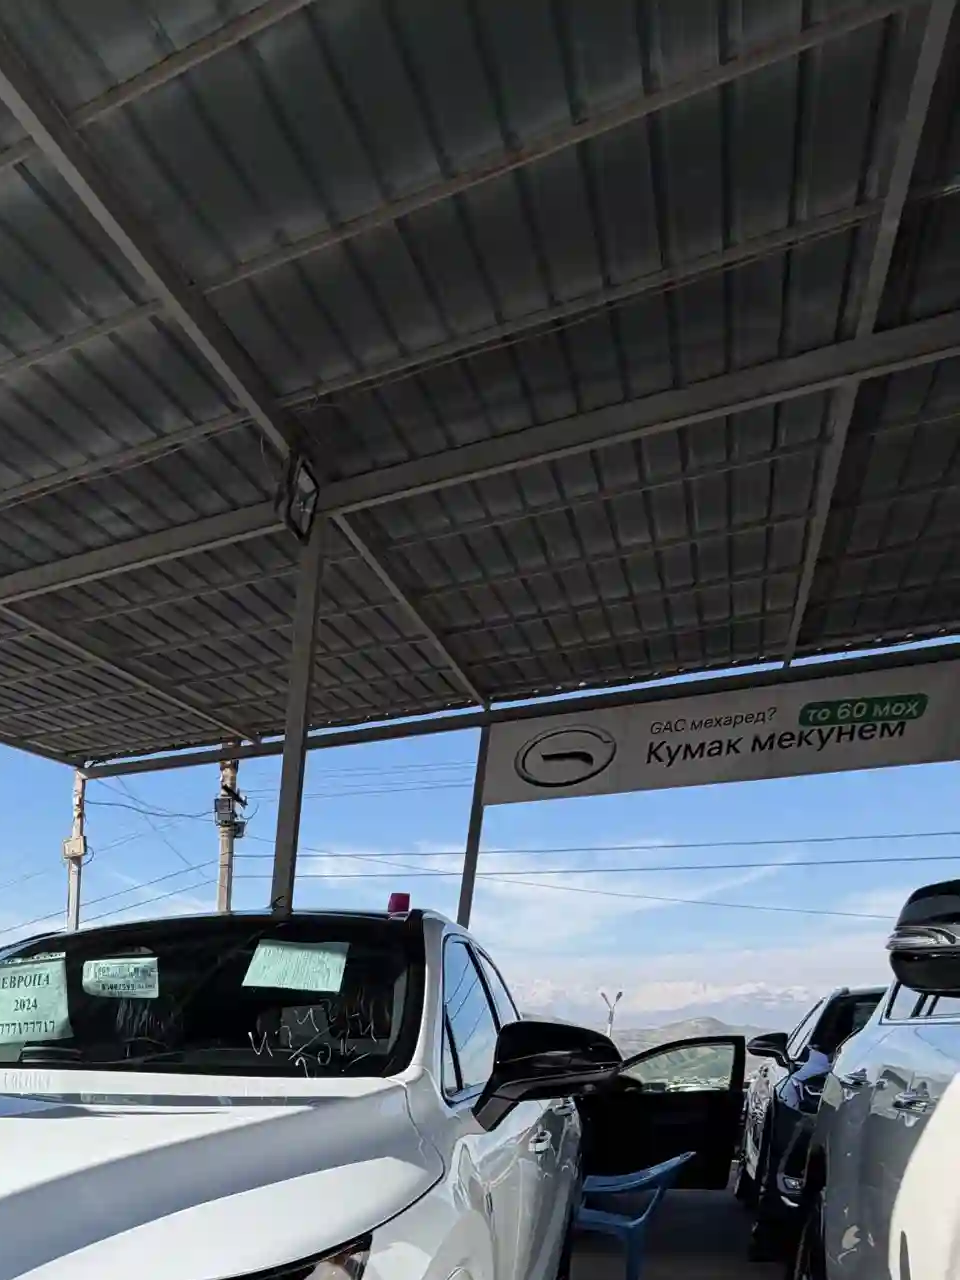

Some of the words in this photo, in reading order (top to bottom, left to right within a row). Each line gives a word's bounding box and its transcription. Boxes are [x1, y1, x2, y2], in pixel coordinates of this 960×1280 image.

[650, 718, 686, 735] GAC
[690, 706, 777, 731] мехаред?
[806, 708, 831, 722] то
[837, 702, 867, 719] 60
[646, 736, 743, 767] Кумак
[751, 721, 907, 753] мекунем
[1, 973, 50, 989] ЕВРОПА
[14, 998, 38, 1012] 2024
